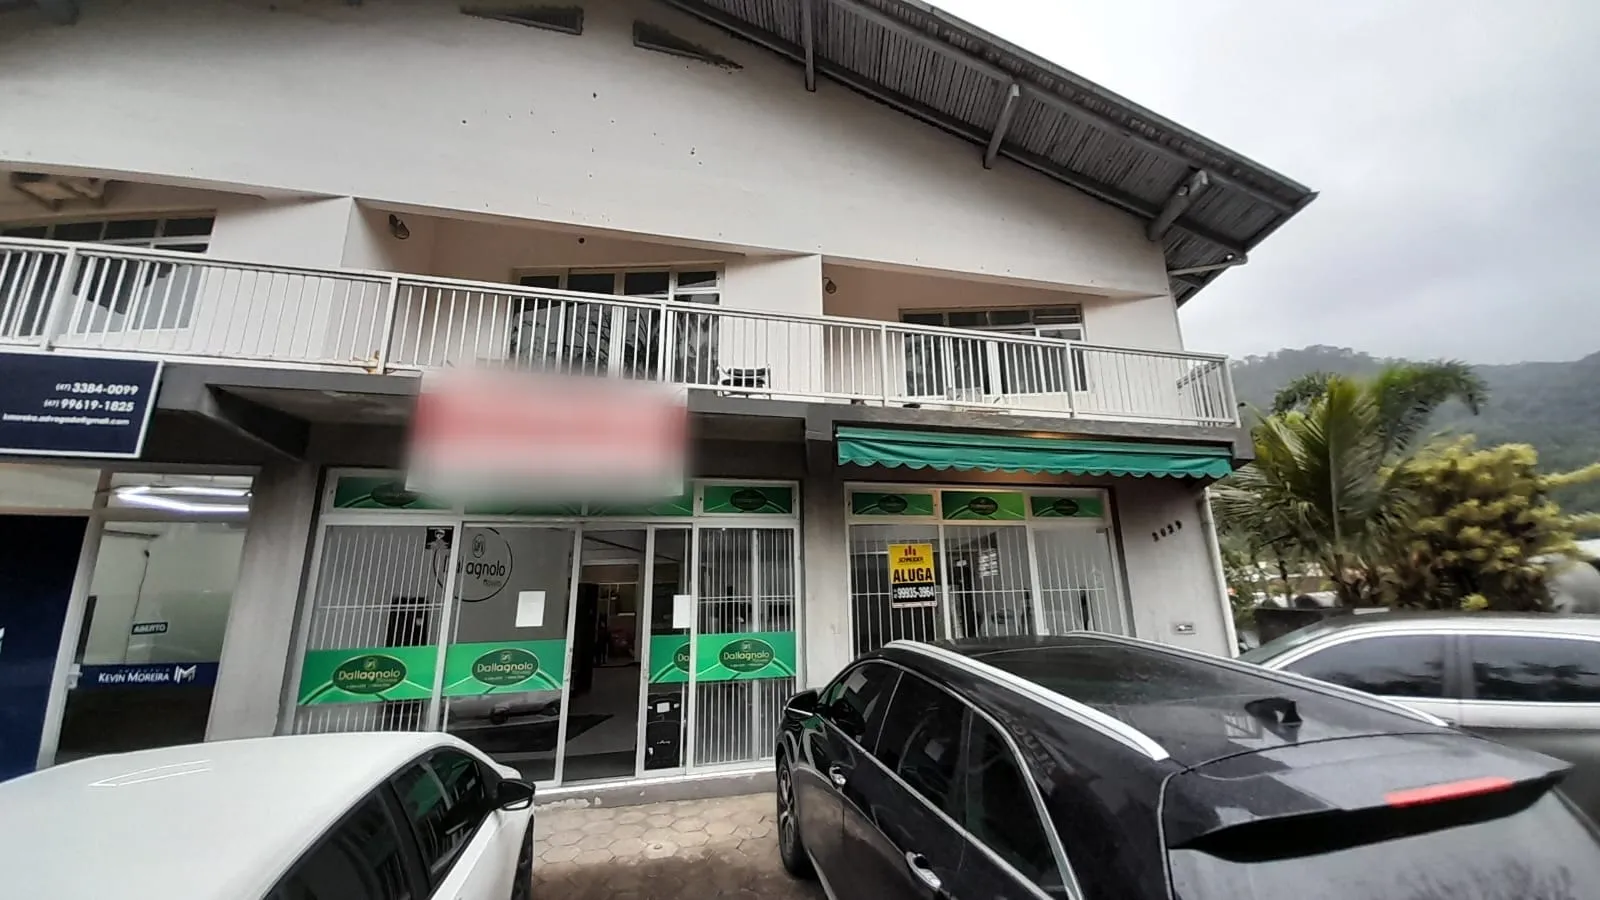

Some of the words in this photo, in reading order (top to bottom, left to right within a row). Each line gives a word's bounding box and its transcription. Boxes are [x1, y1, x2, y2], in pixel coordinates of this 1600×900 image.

[72, 382, 139, 395] 3384-0099
[60, 398, 135, 412] 99619-1825
[893, 567, 933, 582] ALUGA
[723, 650, 770, 662] Dallagnolo
[477, 661, 534, 674] Dallagnolo
[338, 668, 401, 681] Dallagnolo
